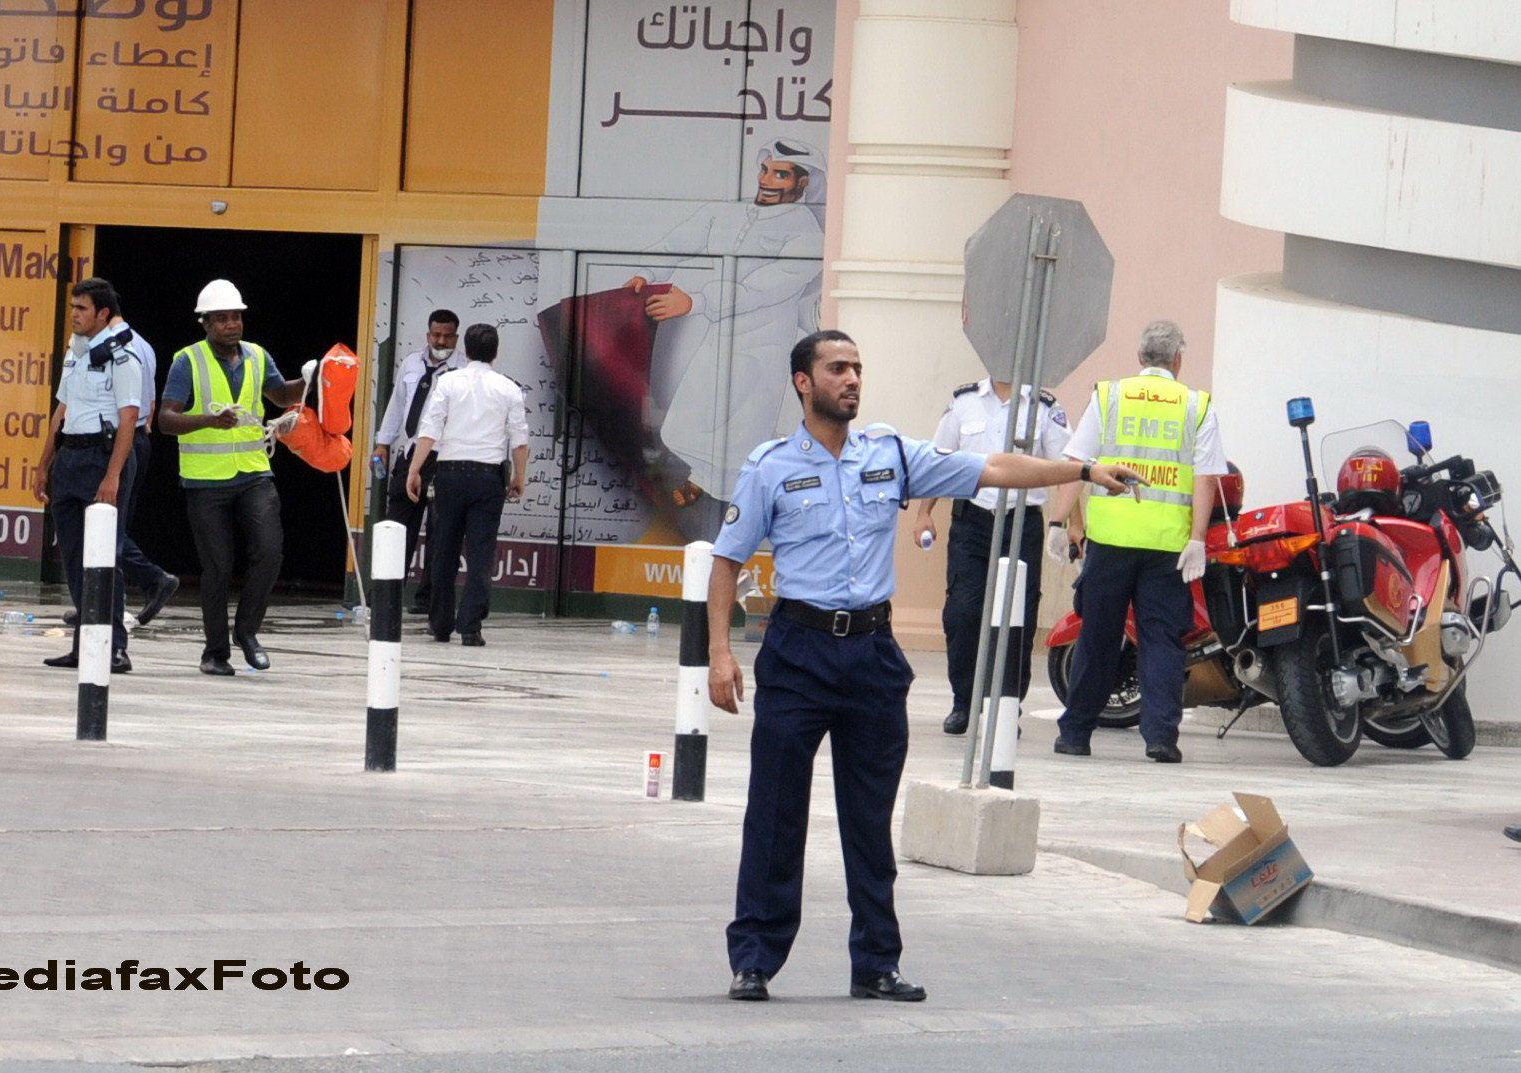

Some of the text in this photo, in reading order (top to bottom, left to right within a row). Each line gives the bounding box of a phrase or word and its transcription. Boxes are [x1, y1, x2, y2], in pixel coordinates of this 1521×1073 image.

[637, 5, 813, 66] واجباتك
[87, 41, 213, 77] إعطاء
[97, 87, 210, 115] كاملة
[143, 136, 207, 165] من
[1122, 416, 1179, 440] EMS
